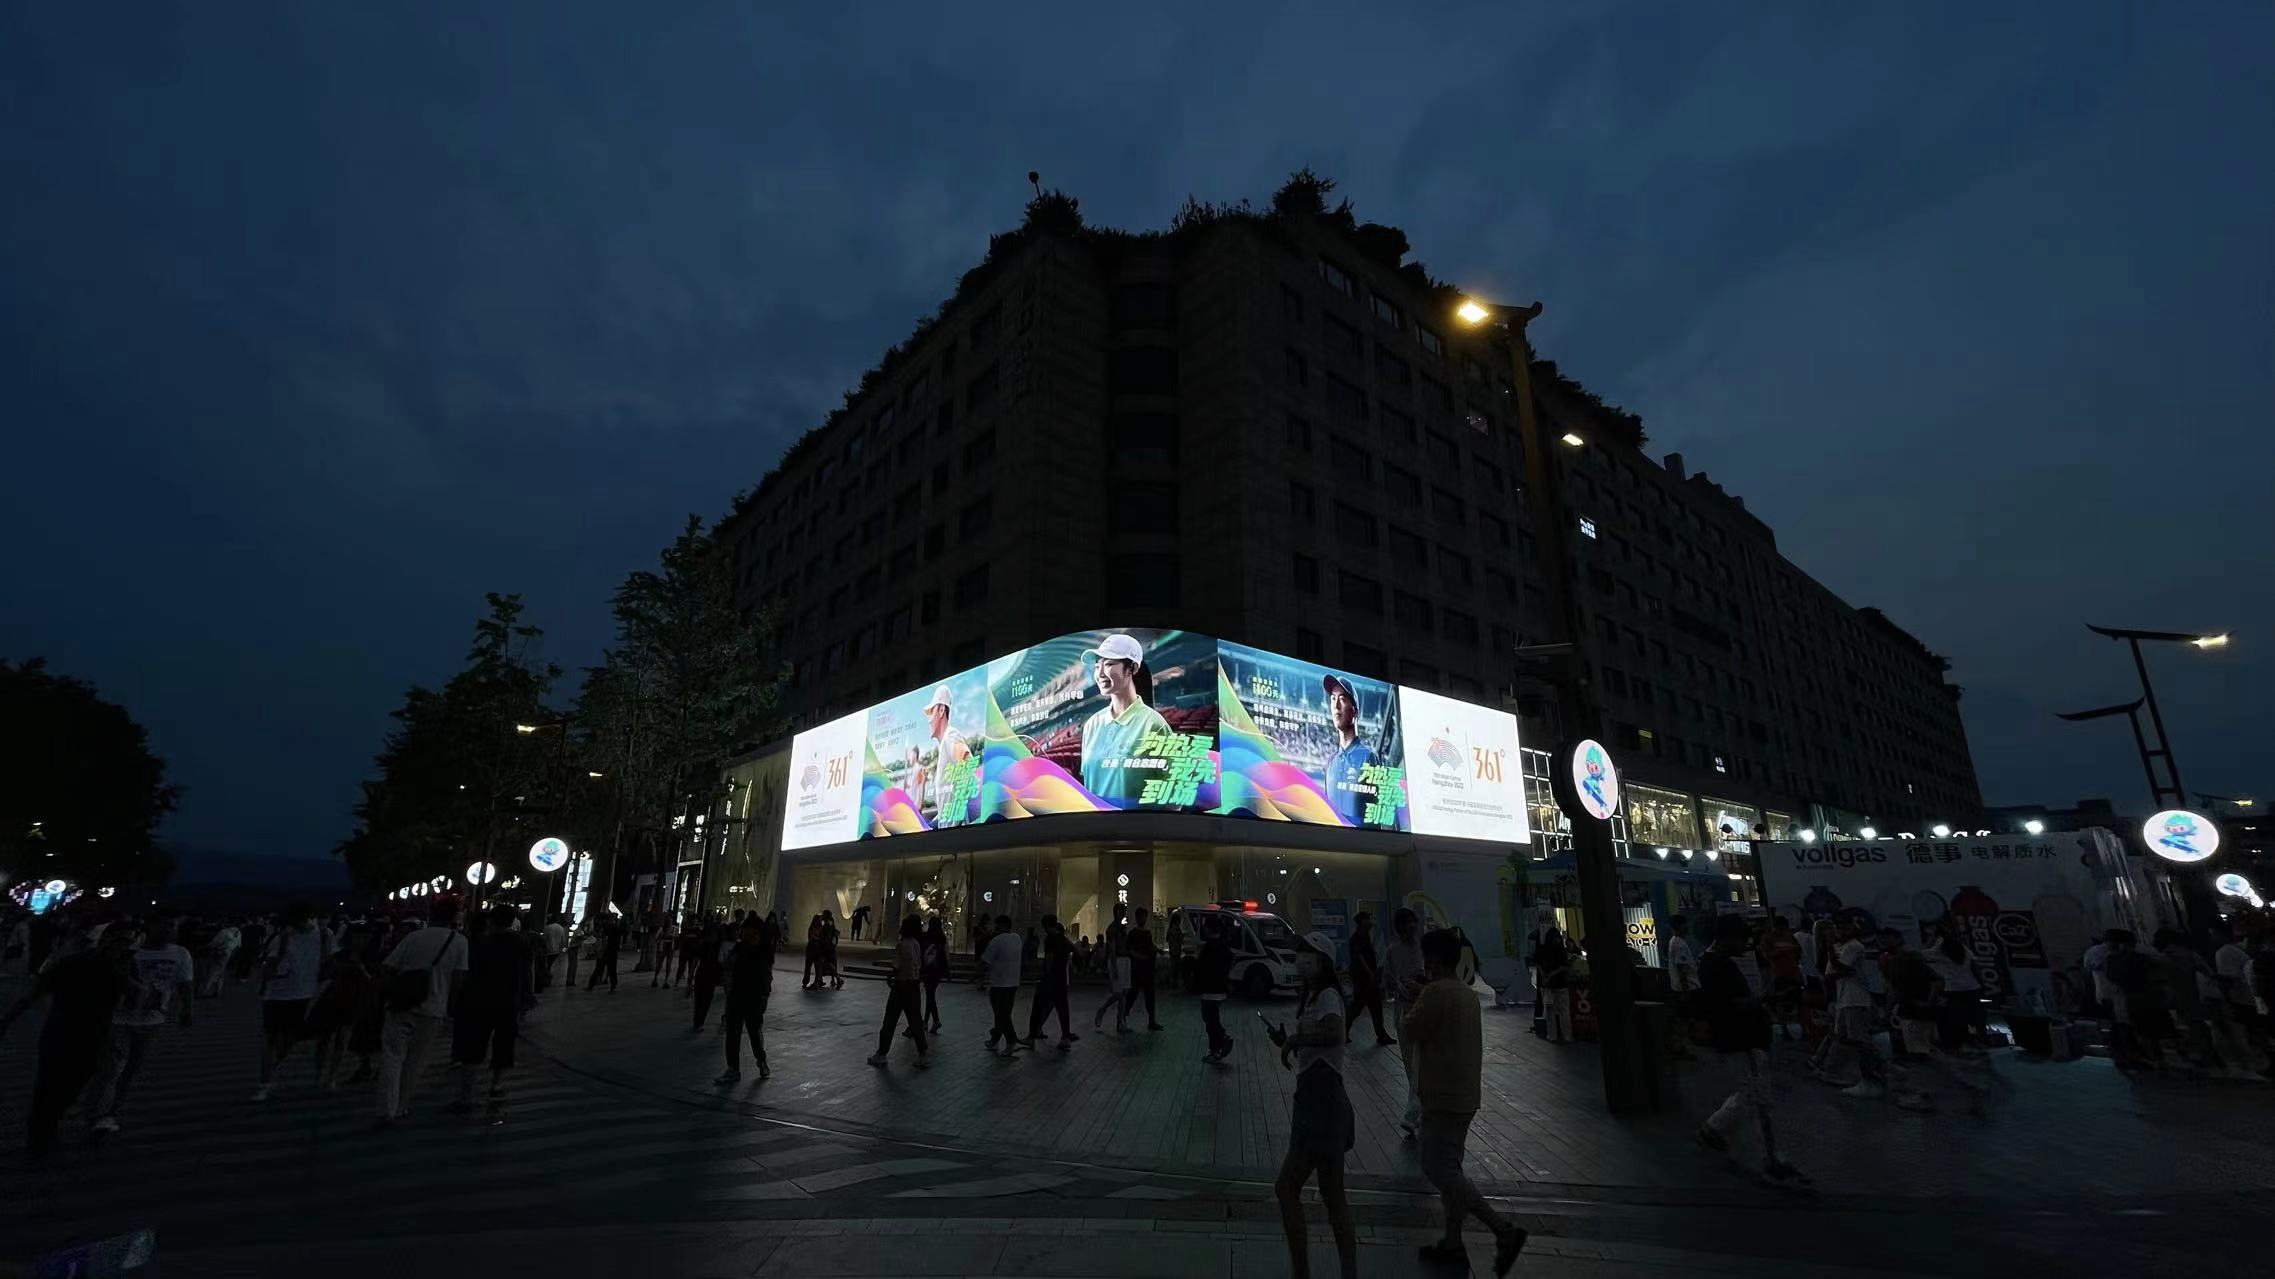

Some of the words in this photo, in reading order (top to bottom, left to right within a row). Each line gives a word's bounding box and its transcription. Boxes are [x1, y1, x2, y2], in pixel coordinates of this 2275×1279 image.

[1133, 731, 1214, 757] 为热爱
[827, 750, 853, 790] 361°
[1168, 757, 1217, 784] 我先
[1358, 762, 1402, 786] 为热爱
[1473, 745, 1505, 785] 361°
[1138, 779, 1199, 806] 到场
[1364, 803, 1395, 826] 到场
[1971, 844, 2056, 859] 电解质水
